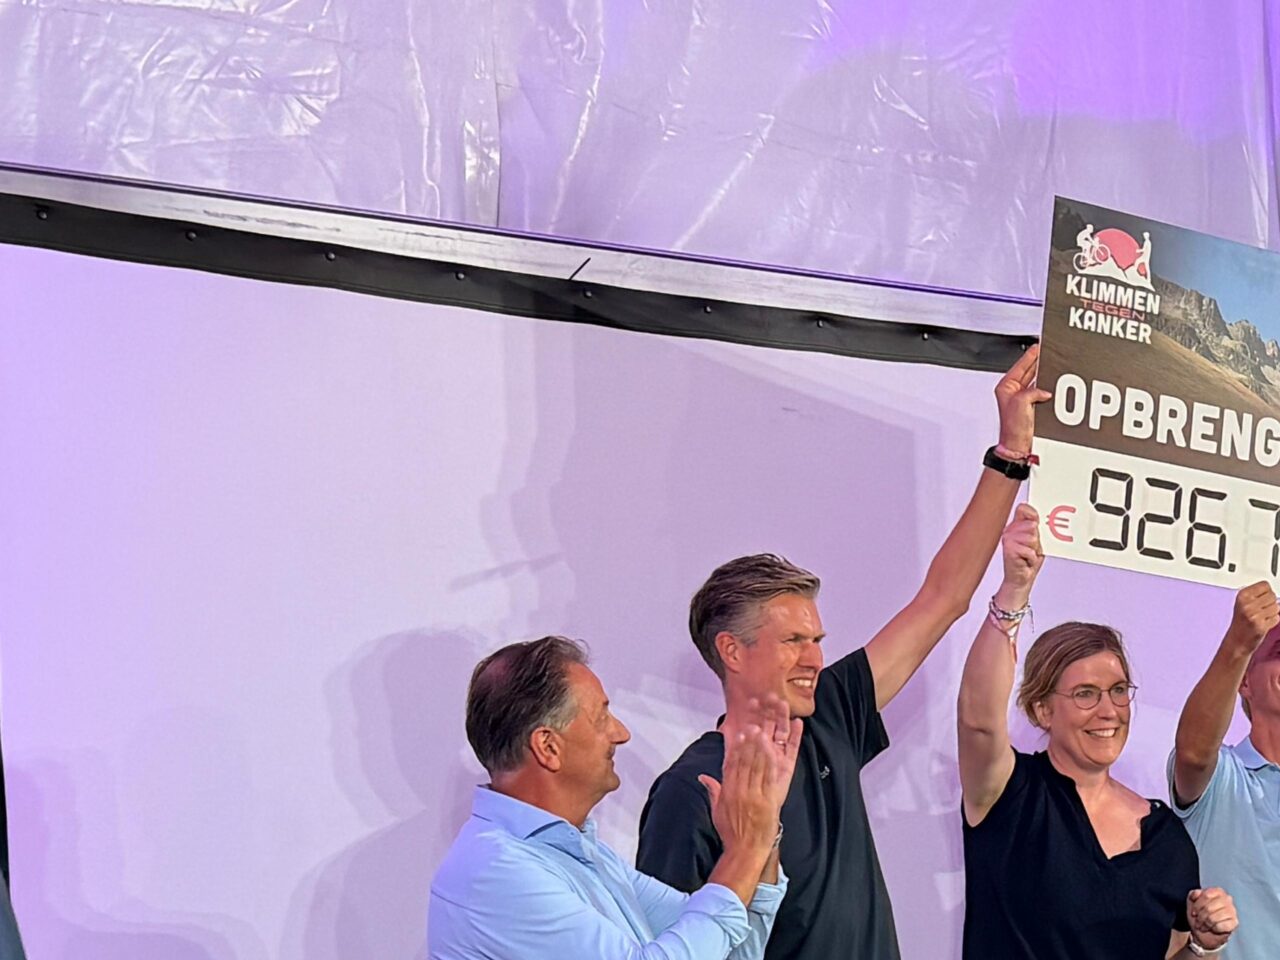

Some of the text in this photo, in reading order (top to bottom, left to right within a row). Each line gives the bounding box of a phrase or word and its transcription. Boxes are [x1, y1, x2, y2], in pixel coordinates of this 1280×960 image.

[1066, 274, 1160, 315] KLIMMEN
[1080, 298, 1146, 321] TEGEN
[1069, 306, 1152, 345] KANKER
